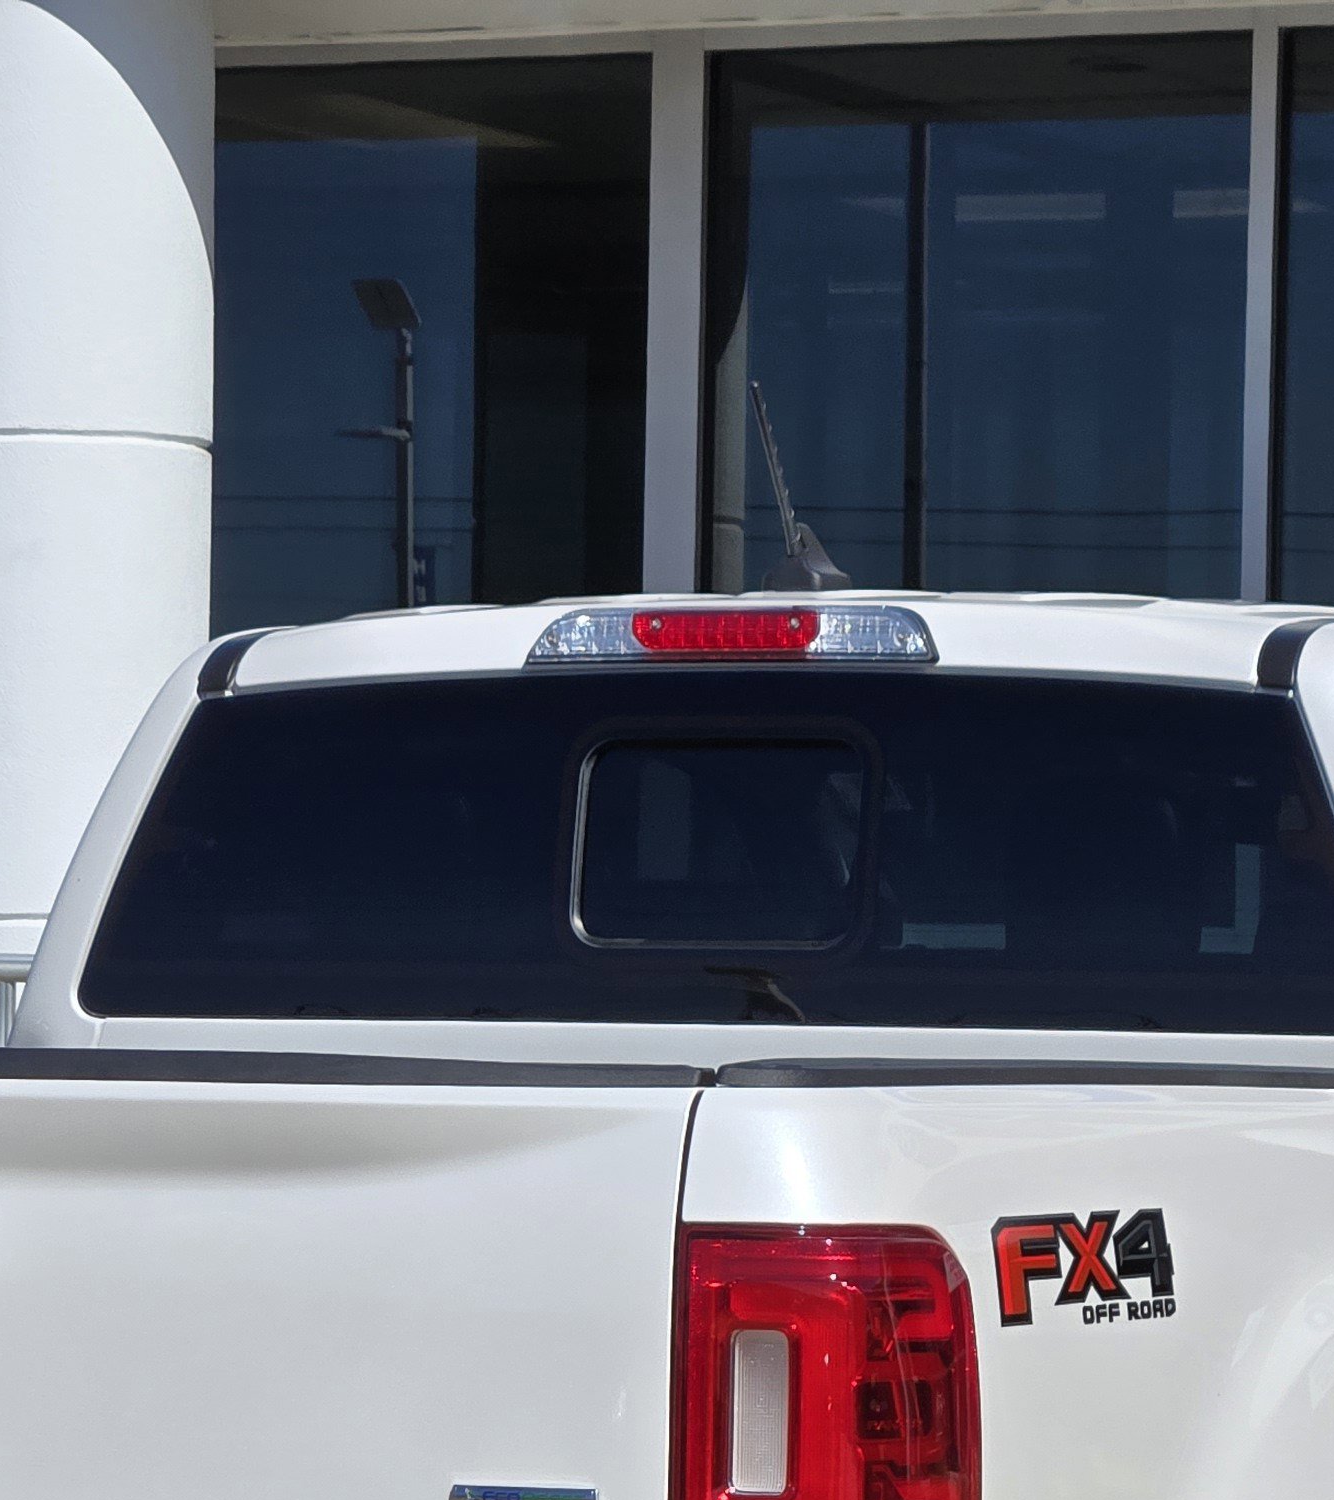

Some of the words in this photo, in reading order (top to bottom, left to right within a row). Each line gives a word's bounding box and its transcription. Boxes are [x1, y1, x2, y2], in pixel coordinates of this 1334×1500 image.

[991, 1208, 1175, 1328] FX4
[1082, 1303, 1121, 1325] OFF
[1127, 1298, 1177, 1321] ROAD
